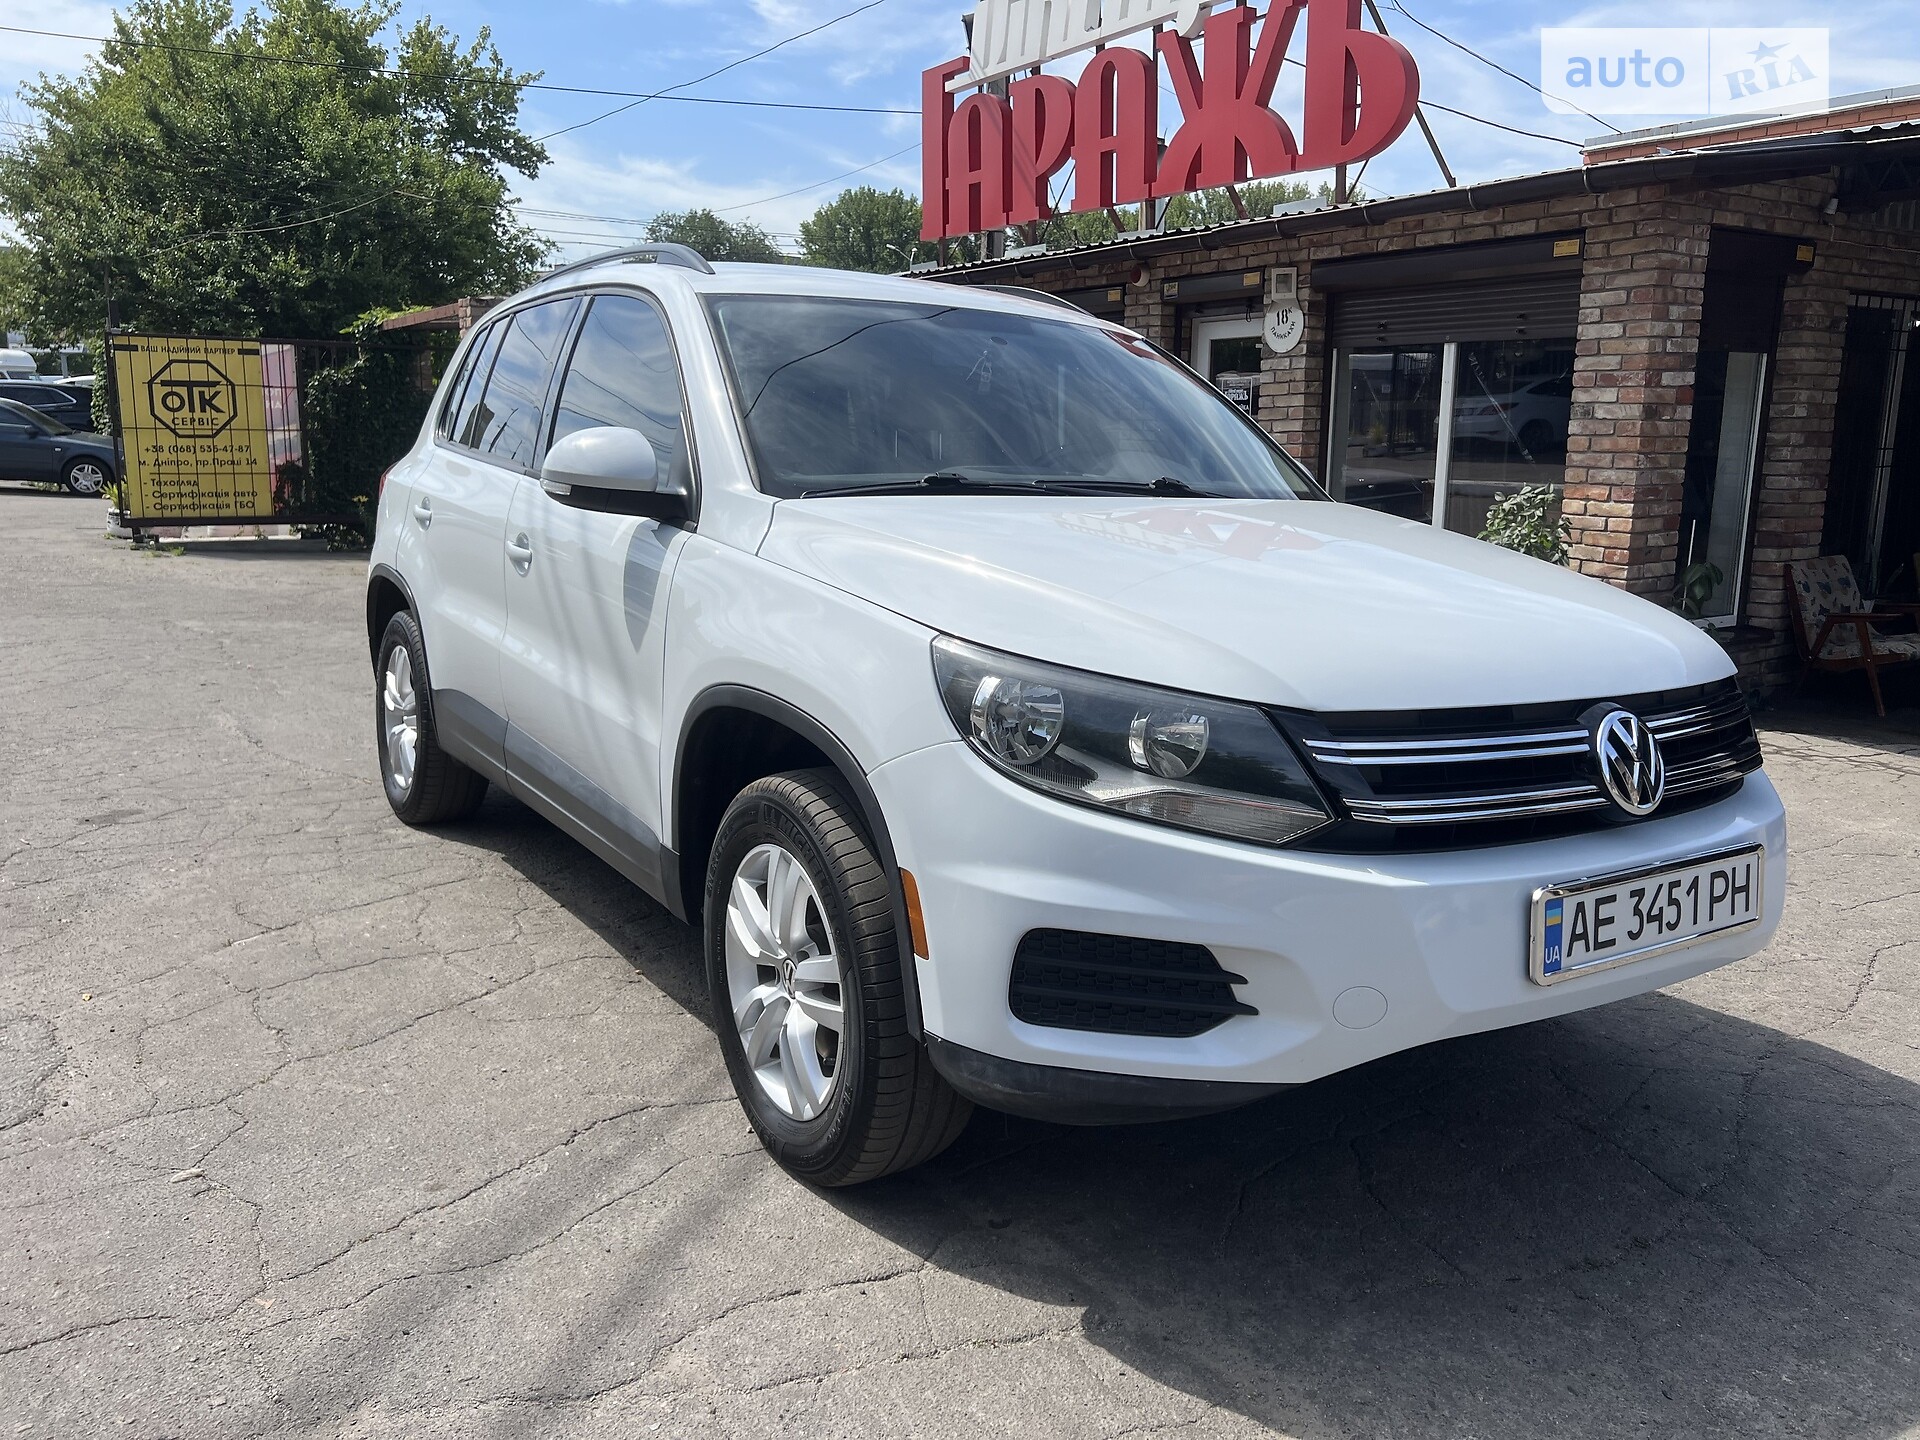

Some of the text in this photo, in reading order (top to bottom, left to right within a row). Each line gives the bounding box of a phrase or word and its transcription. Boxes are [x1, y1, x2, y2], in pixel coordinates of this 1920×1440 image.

[140, 345, 158, 353] ВАШ
[160, 380, 226, 414] ОТК
[171, 417, 220, 426] СЕРВІС
[144, 444, 164, 453] +38
[168, 444, 197, 455] (068)
[153, 457, 193, 467] Дніпро,
[245, 457, 257, 465] 14
[233, 490, 258, 498] авто
[1566, 863, 1751, 958] AE 3451 PH
[1544, 945, 1561, 964] UA
